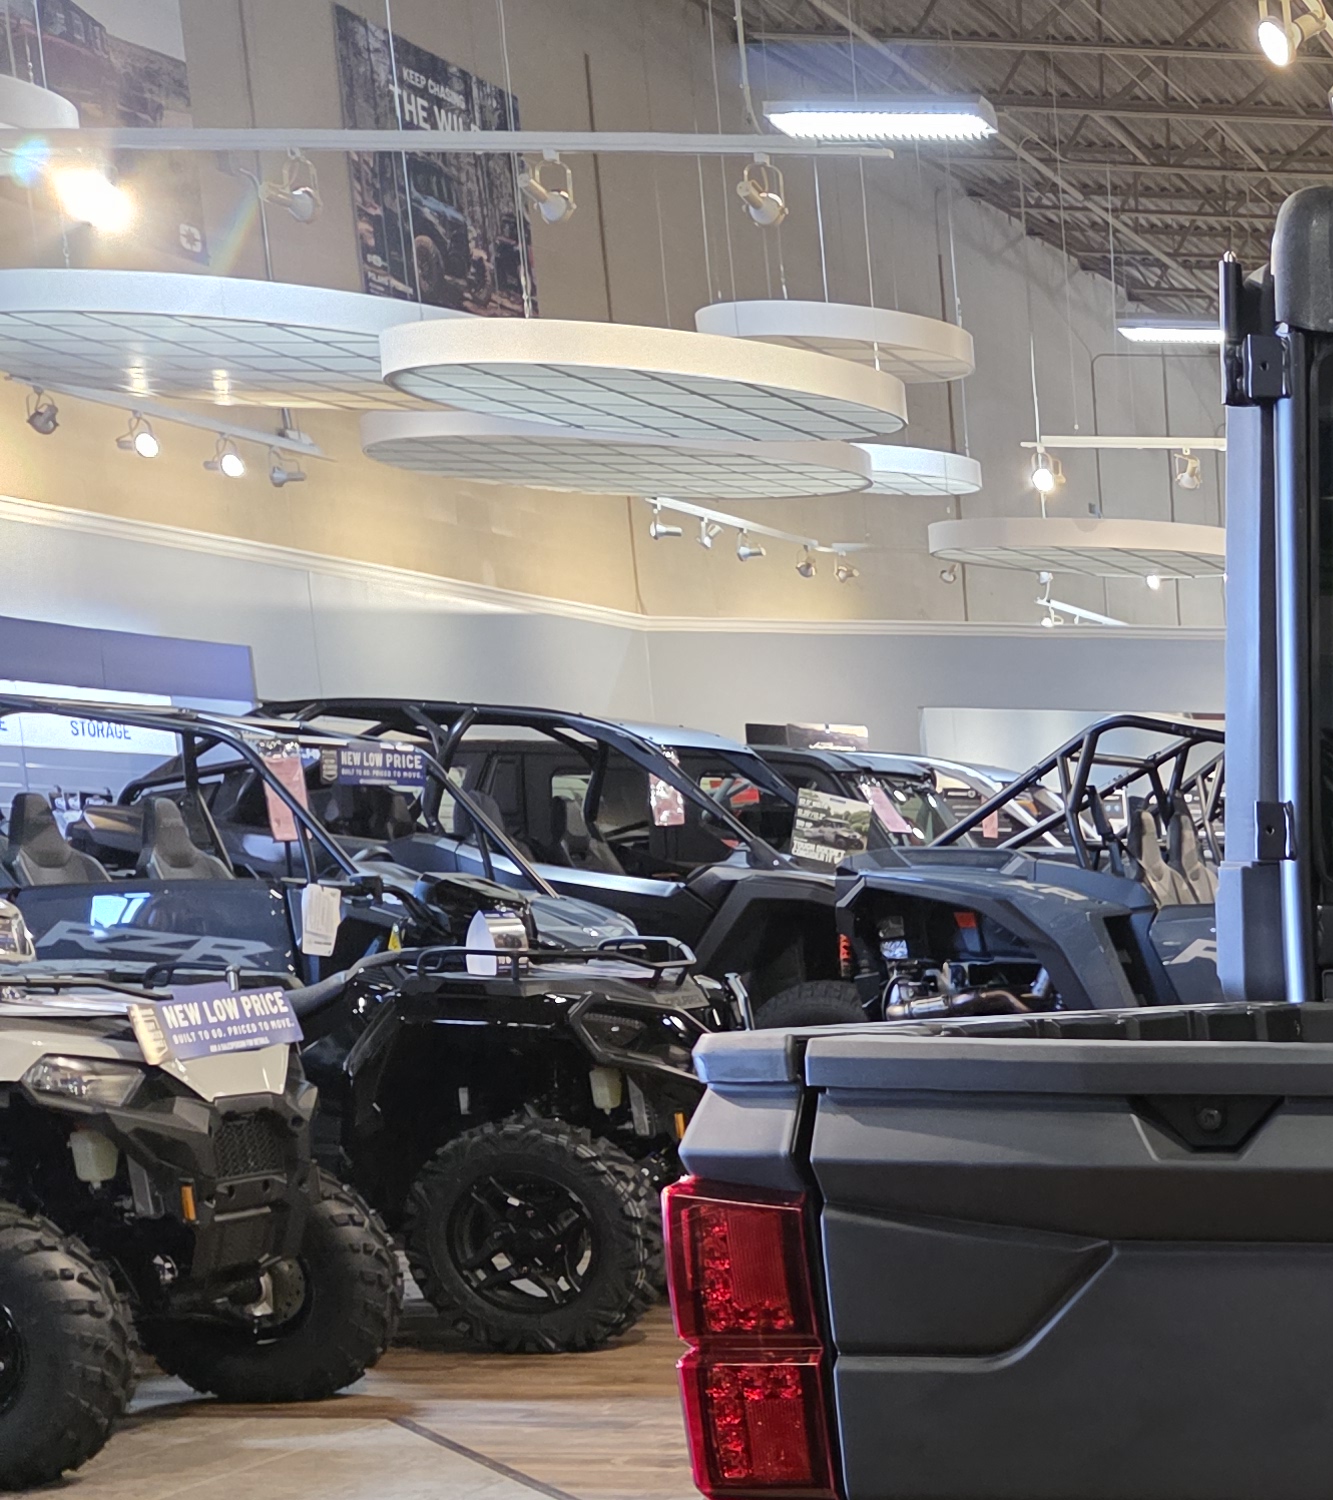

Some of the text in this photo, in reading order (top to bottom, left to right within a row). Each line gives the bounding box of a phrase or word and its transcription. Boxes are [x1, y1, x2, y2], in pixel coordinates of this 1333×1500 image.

[402, 67, 466, 109] KEEP CHASING
[389, 83, 482, 131] THE WI
[70, 720, 132, 741] STORAGE
[341, 751, 362, 766] NEW
[363, 752, 383, 767] LOW
[386, 753, 423, 769] PRICE
[372, 769, 392, 778] PRICED
[393, 770, 402, 778] TO
[35, 919, 274, 968] RZR
[161, 991, 289, 1029] NEW LOW PRICE
[172, 1031, 197, 1045] BUILT
[198, 1030, 210, 1040] TO
[227, 1022, 257, 1036] PRICED
[258, 1021, 270, 1031] TO
[271, 1017, 295, 1030] MOVE.
